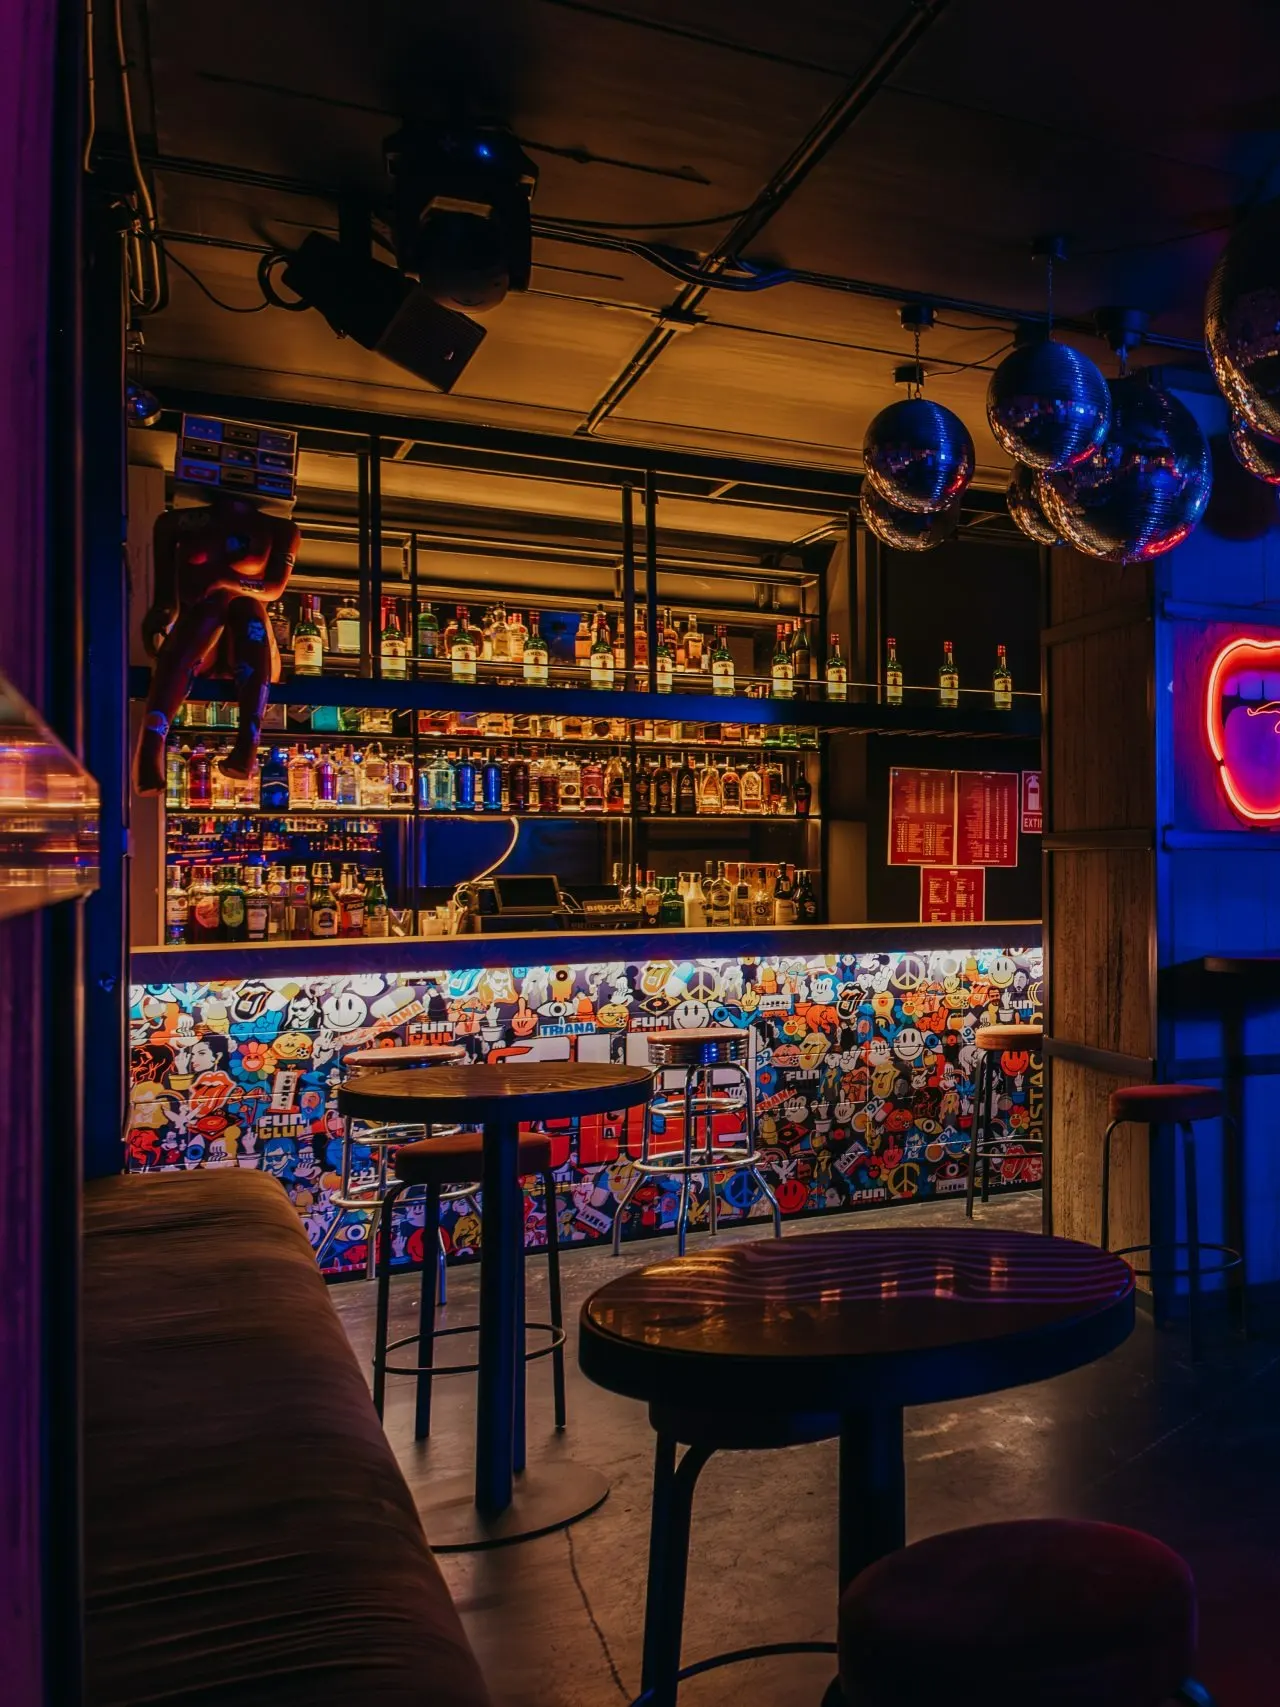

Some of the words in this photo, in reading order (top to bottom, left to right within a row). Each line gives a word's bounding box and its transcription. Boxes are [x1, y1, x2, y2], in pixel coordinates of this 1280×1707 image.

[409, 1022, 453, 1034] FUN
[542, 1022, 594, 1036] TRIANA
[632, 1016, 669, 1028] FUN
[963, 1028, 976, 1044] 92
[784, 1070, 819, 1081] FUN
[259, 1113, 306, 1128] FUN
[853, 1187, 884, 1201] FUN
